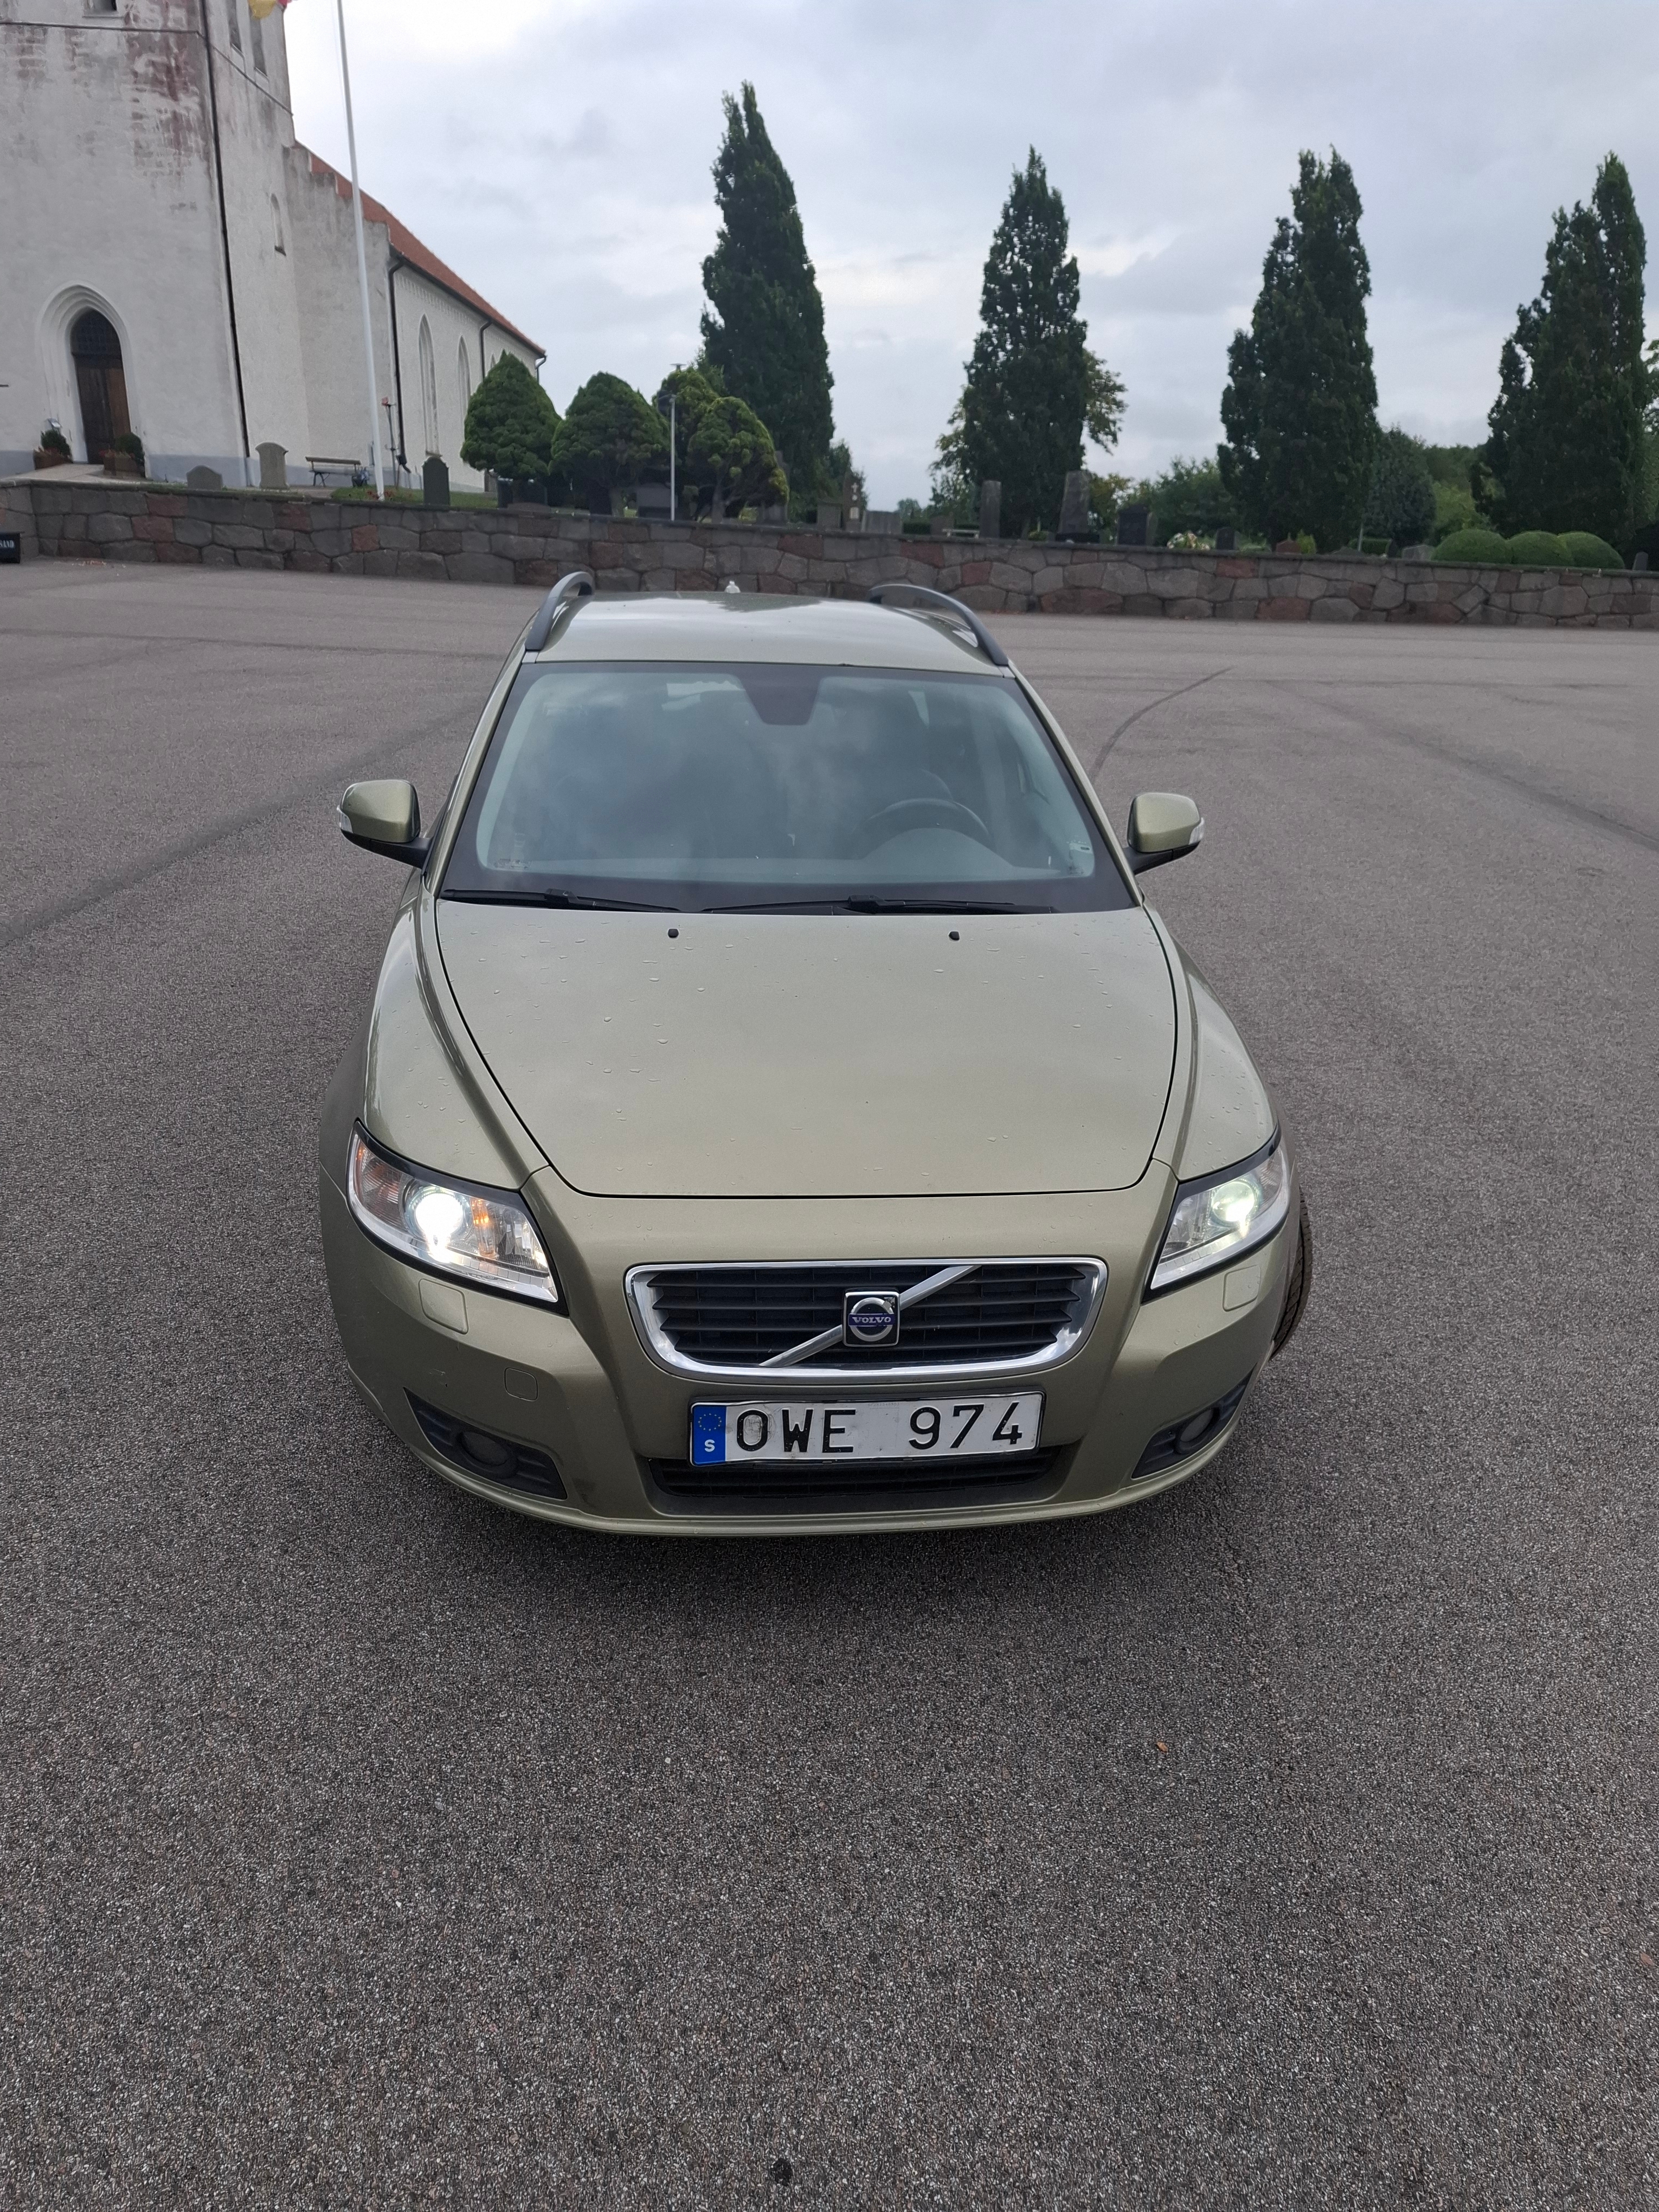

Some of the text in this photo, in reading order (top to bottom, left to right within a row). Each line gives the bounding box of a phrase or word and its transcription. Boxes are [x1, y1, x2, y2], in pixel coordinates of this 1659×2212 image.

[736, 1401, 1023, 1454] OWE 974
[704, 1439, 715, 1452] S
